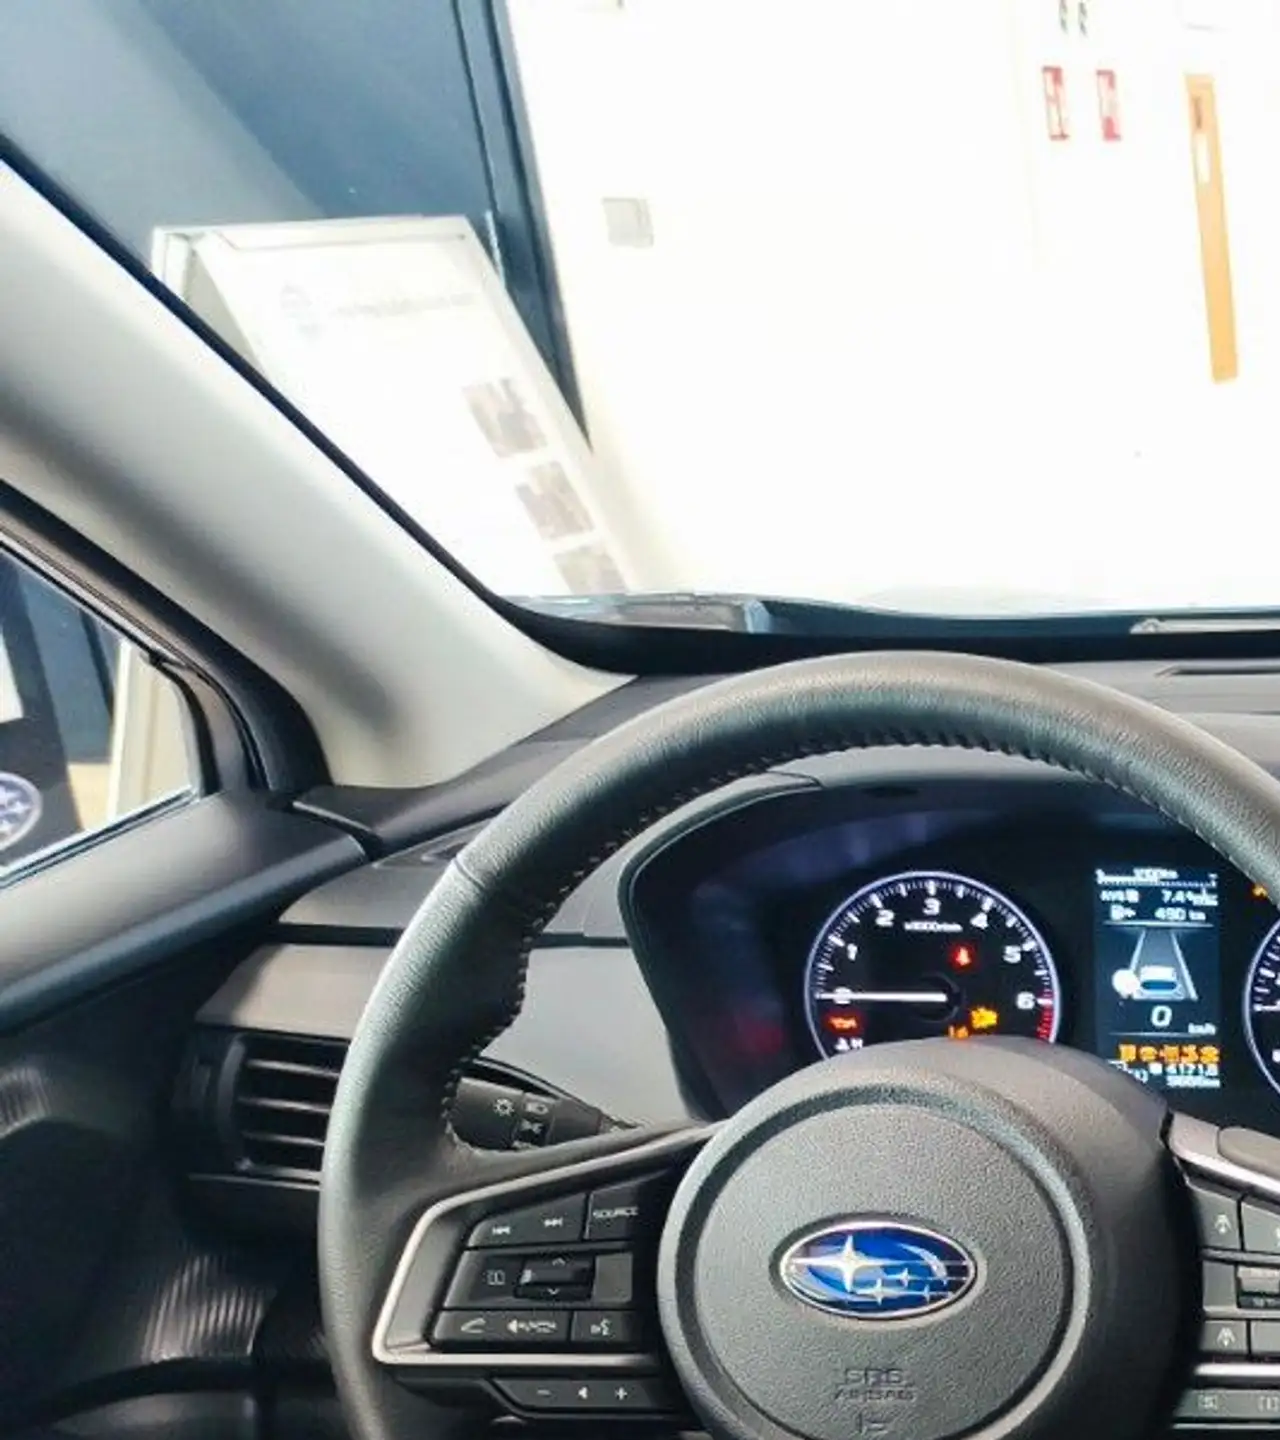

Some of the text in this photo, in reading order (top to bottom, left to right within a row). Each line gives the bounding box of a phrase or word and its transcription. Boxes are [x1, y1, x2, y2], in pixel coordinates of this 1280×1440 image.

[923, 898, 941, 915] 3
[875, 910, 895, 927] 2
[970, 912, 988, 929] 4
[847, 943, 858, 960] 1
[1003, 946, 1021, 963] 5
[1016, 992, 1036, 1010] 6
[1151, 1005, 1172, 1028] 0
